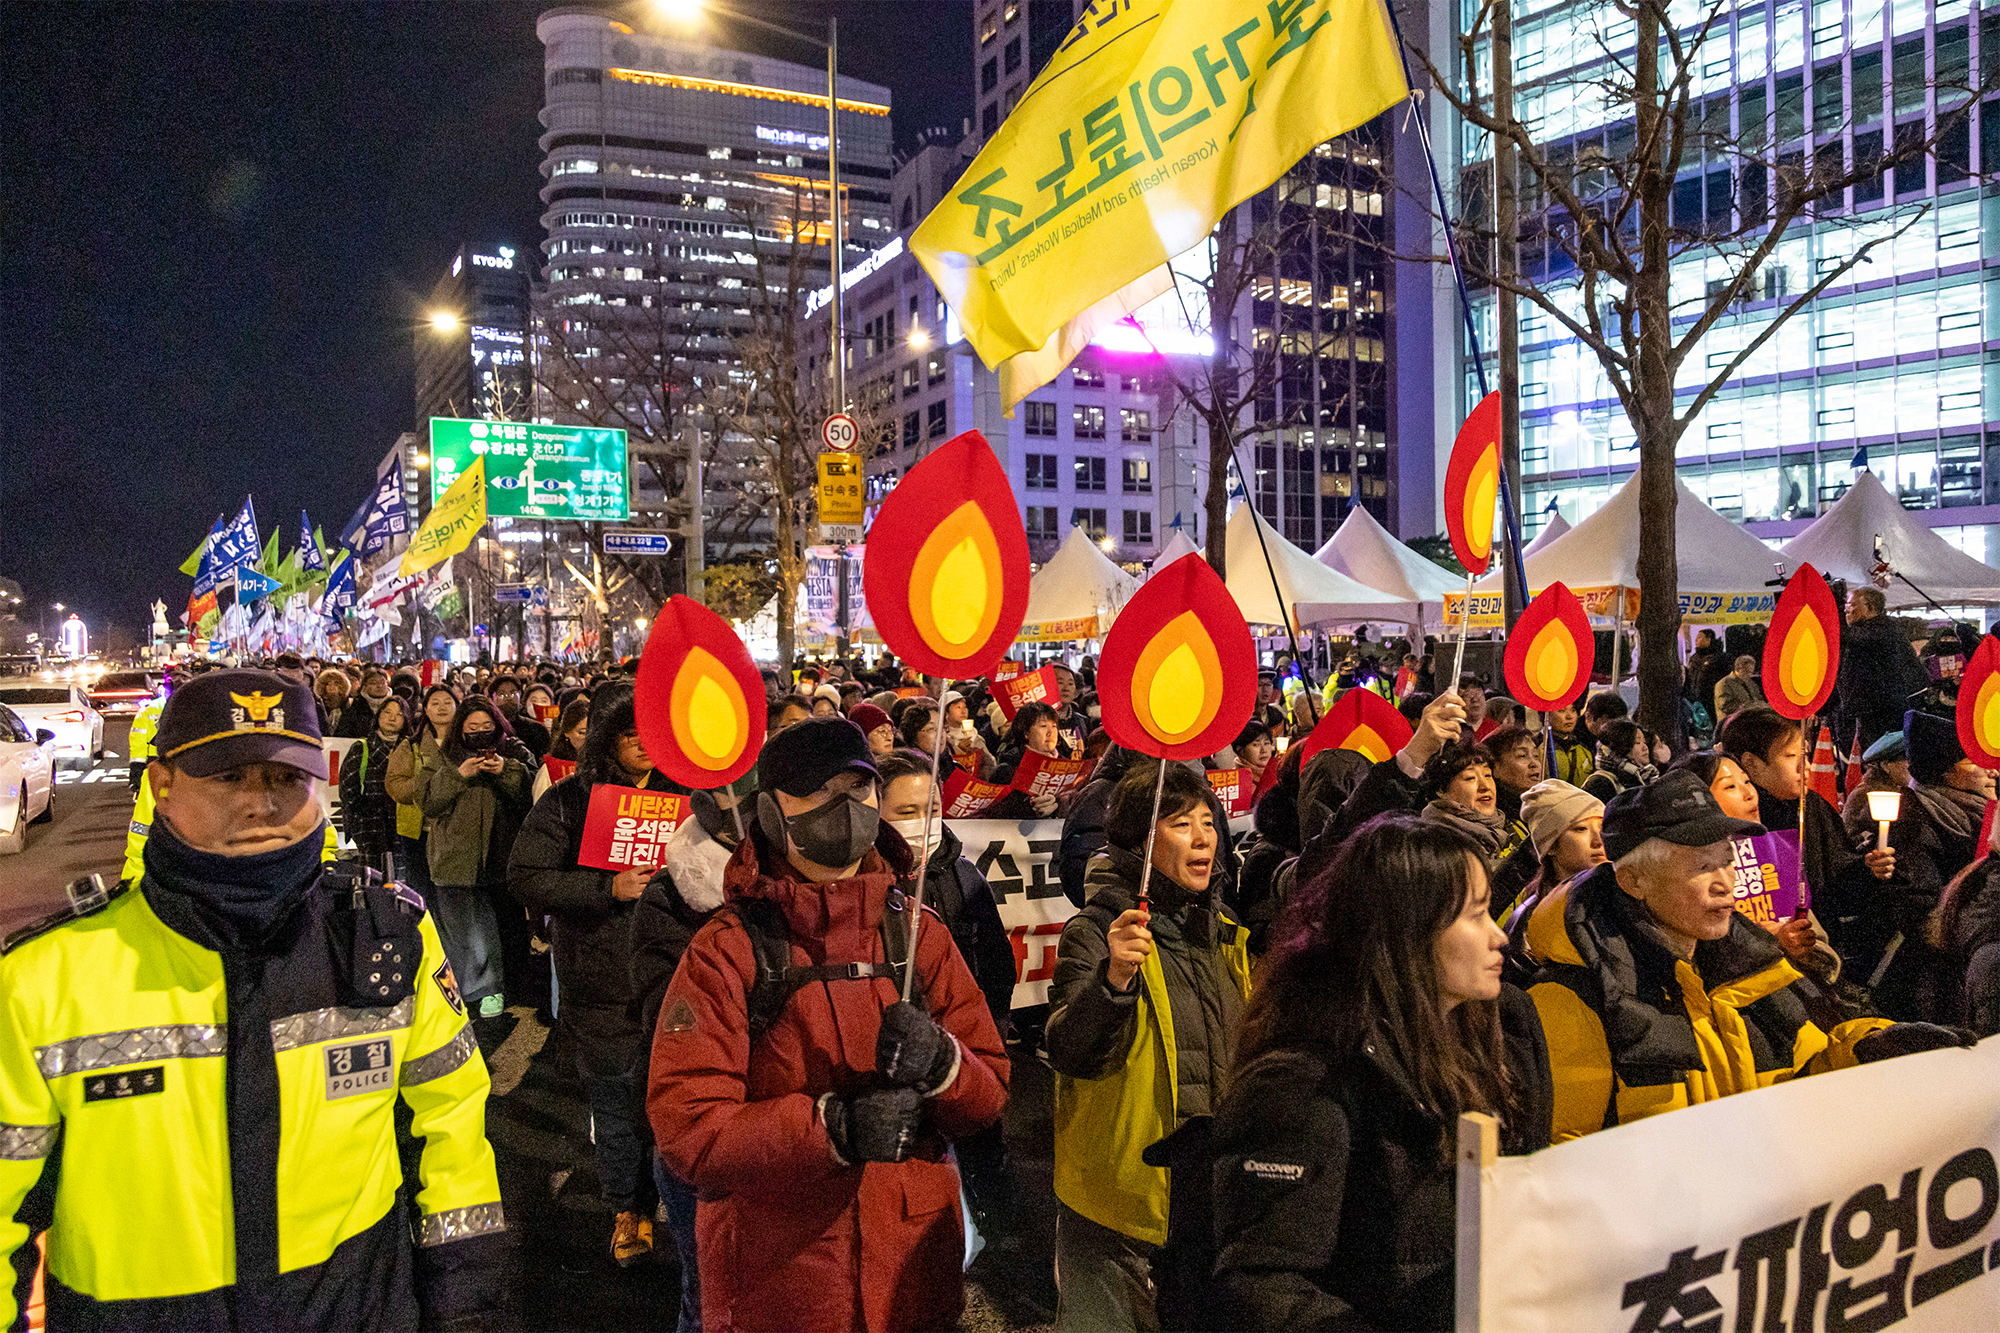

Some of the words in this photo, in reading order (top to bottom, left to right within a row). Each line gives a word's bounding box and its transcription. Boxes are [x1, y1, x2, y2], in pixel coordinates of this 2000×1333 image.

[473, 254, 514, 270] KYOBO
[830, 424, 852, 441] 50
[533, 442, 565, 455] 光化門
[506, 478, 513, 488] 6
[548, 480, 554, 490] 6
[823, 485, 858, 497] 단속중
[831, 500, 852, 508] Photo
[829, 526, 857, 537] 300m
[238, 579, 268, 592] 14기-2
[807, 577, 832, 596] FESTA
[1726, 594, 1775, 614] 함께하
[1005, 670, 1044, 696] 내란죄
[1010, 684, 1047, 709] 윤석열
[230, 707, 286, 723] 경찰
[1040, 759, 1085, 775] 내란죄
[1034, 771, 1079, 787] 윤석열
[963, 780, 1005, 799] 내란죄
[1210, 784, 1240, 801] 석열
[617, 794, 681, 820] 내란죄
[613, 817, 677, 843] 윤석열
[608, 841, 660, 867] 퇴진!
[1734, 894, 1776, 923] 열자!
[332, 1042, 387, 1074] 경찰
[333, 1071, 389, 1092] POLICE
[1244, 1160, 1304, 1178] Discovery
